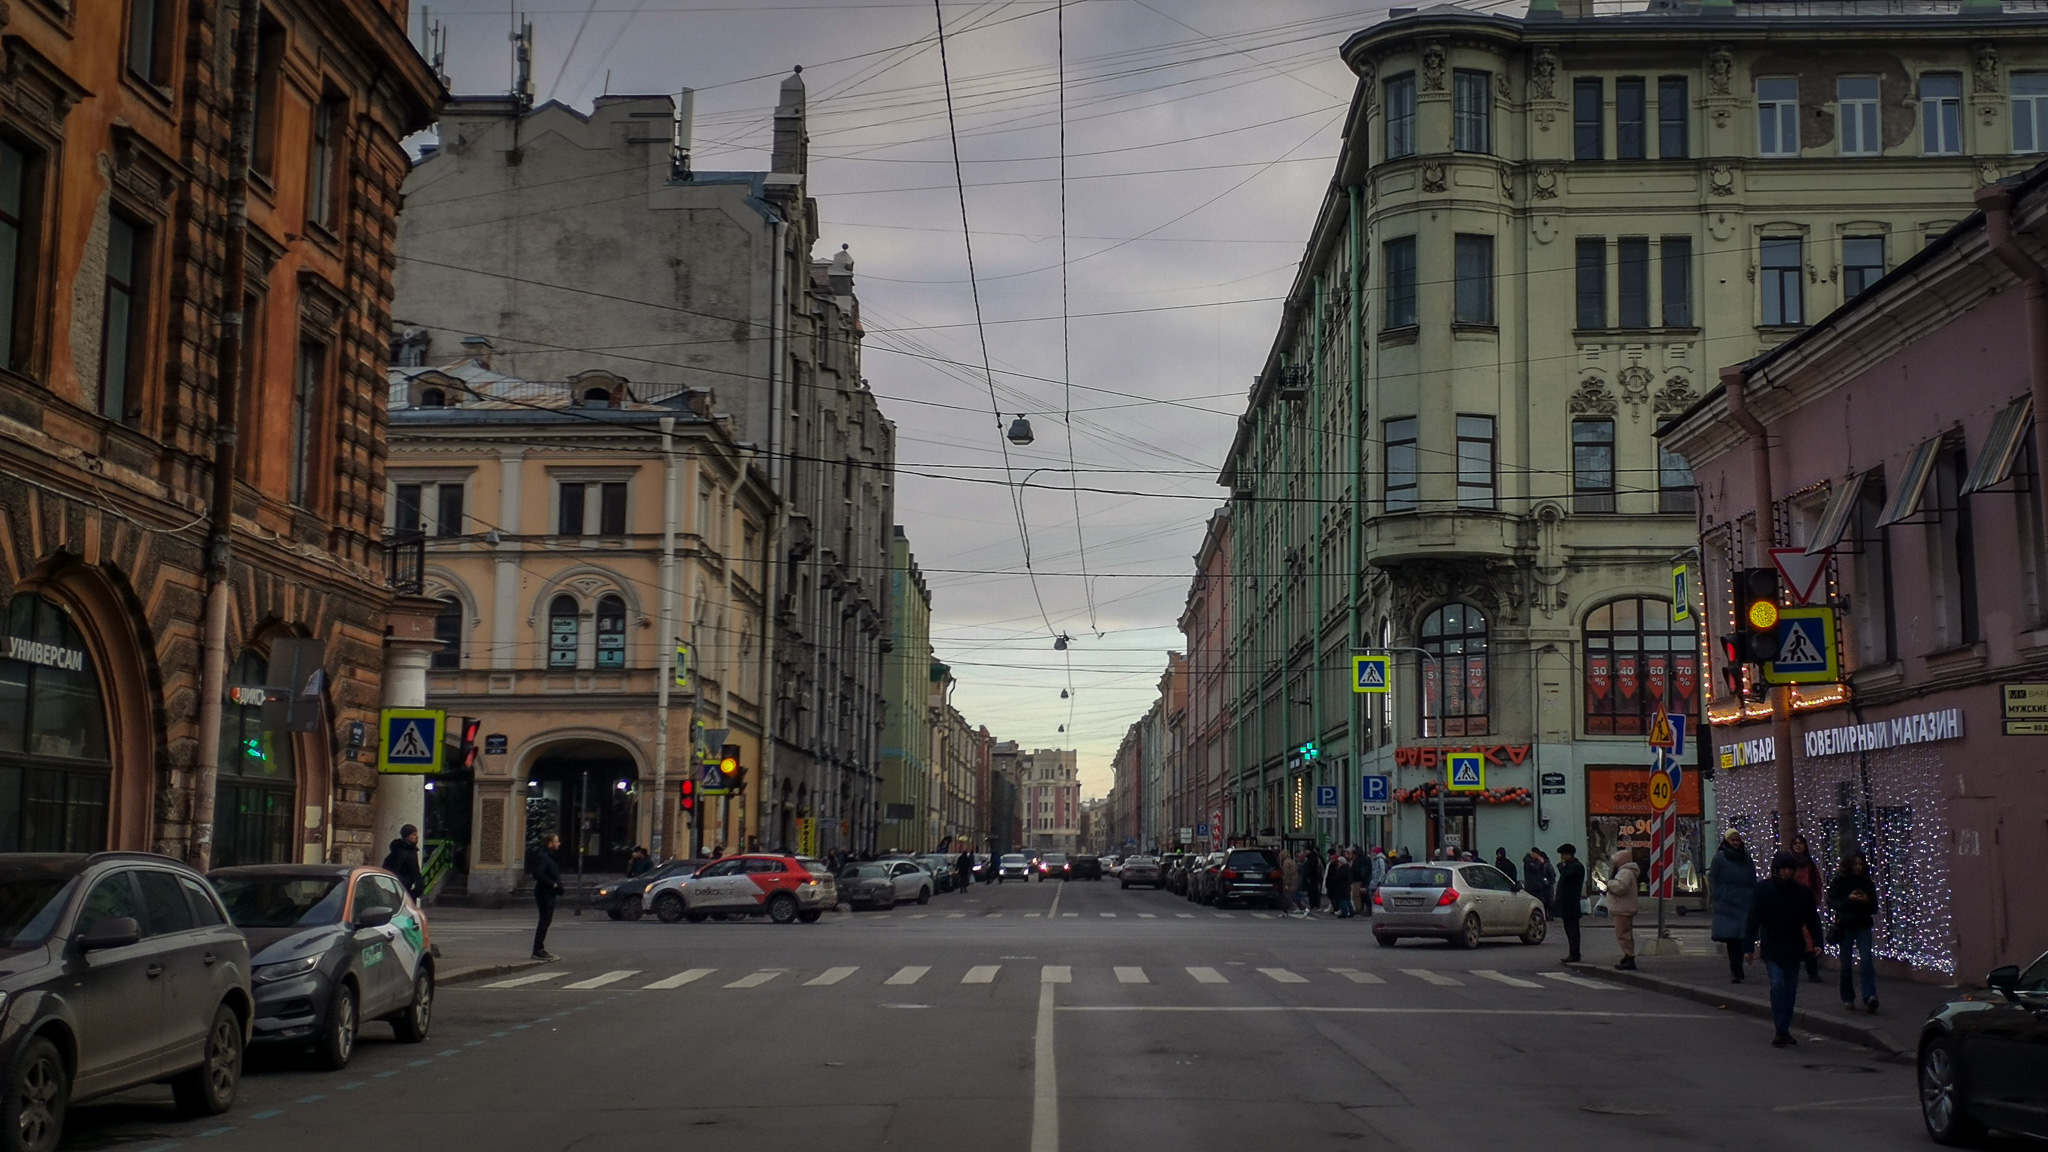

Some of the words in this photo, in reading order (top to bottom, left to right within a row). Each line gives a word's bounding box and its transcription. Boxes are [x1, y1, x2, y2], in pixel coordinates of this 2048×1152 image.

[9, 636, 82, 671] УНИВЕРСАМ
[1593, 666, 1607, 675] 30
[1620, 666, 1634, 675] 40
[1650, 666, 1664, 675] 60
[1678, 666, 1692, 675] 70
[1595, 677, 1605, 686] %
[1622, 677, 1632, 686] %
[1652, 677, 1662, 686] %
[1680, 677, 1690, 686] %
[2008, 705, 2048, 713] МУЖСКИЕ
[1805, 722, 1887, 757] ЮВЕЛИРНЫЙ
[1891, 708, 1958, 746] МАГАЗИН
[1395, 744, 1530, 766] ФАБРКА
[1654, 783, 1668, 798] 40
